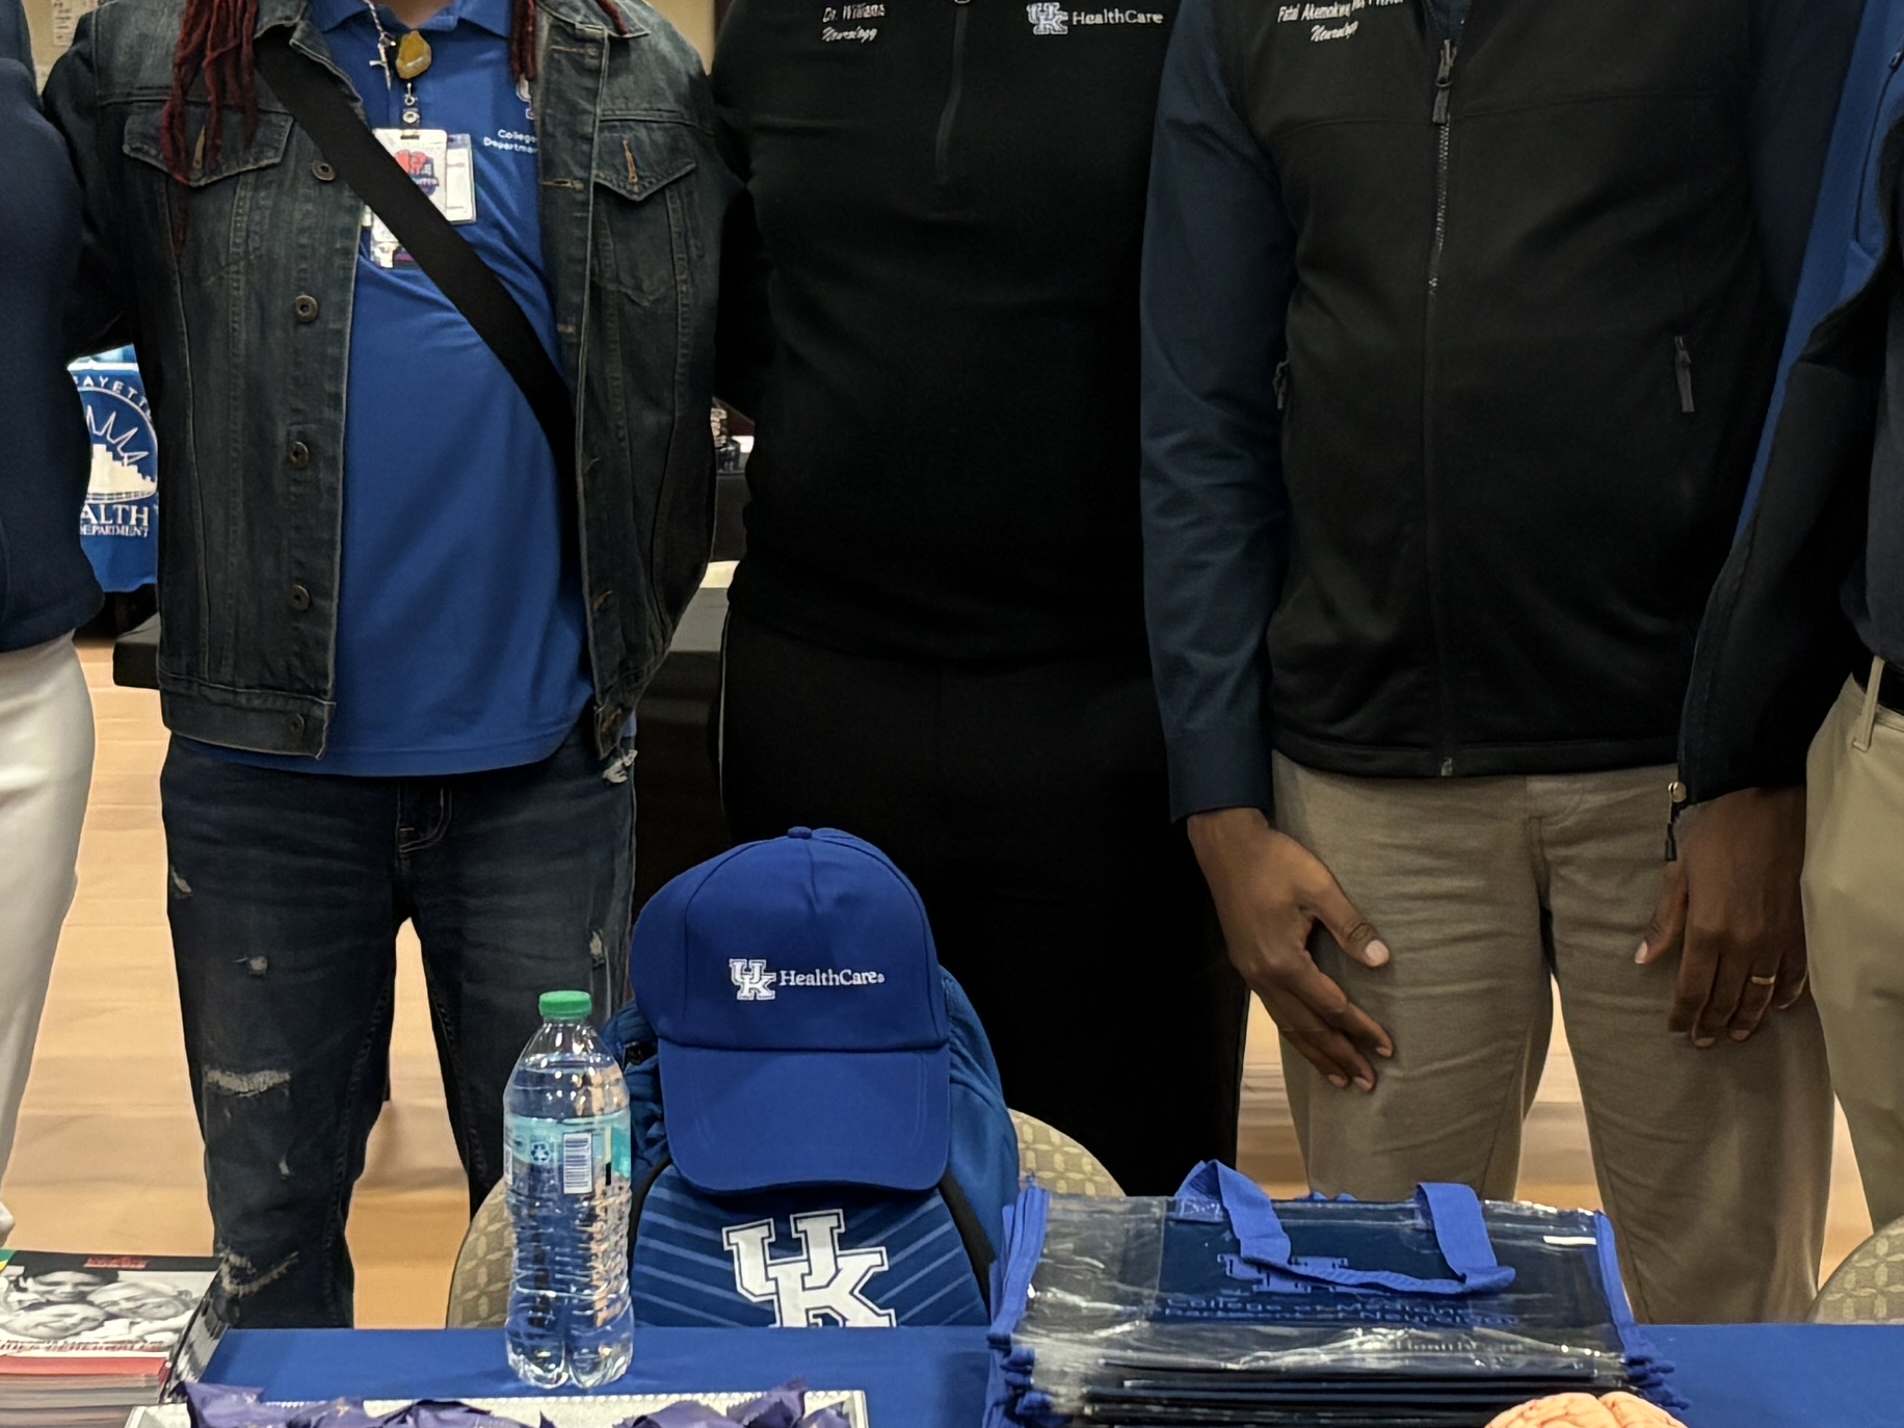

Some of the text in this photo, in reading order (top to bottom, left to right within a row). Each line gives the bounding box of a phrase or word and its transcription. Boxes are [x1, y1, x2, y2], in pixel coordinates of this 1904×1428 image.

[1026, 2, 1164, 35] UK HealthCare
[729, 958, 878, 1001] UK HealthCare
[722, 1209, 897, 1328] UK
